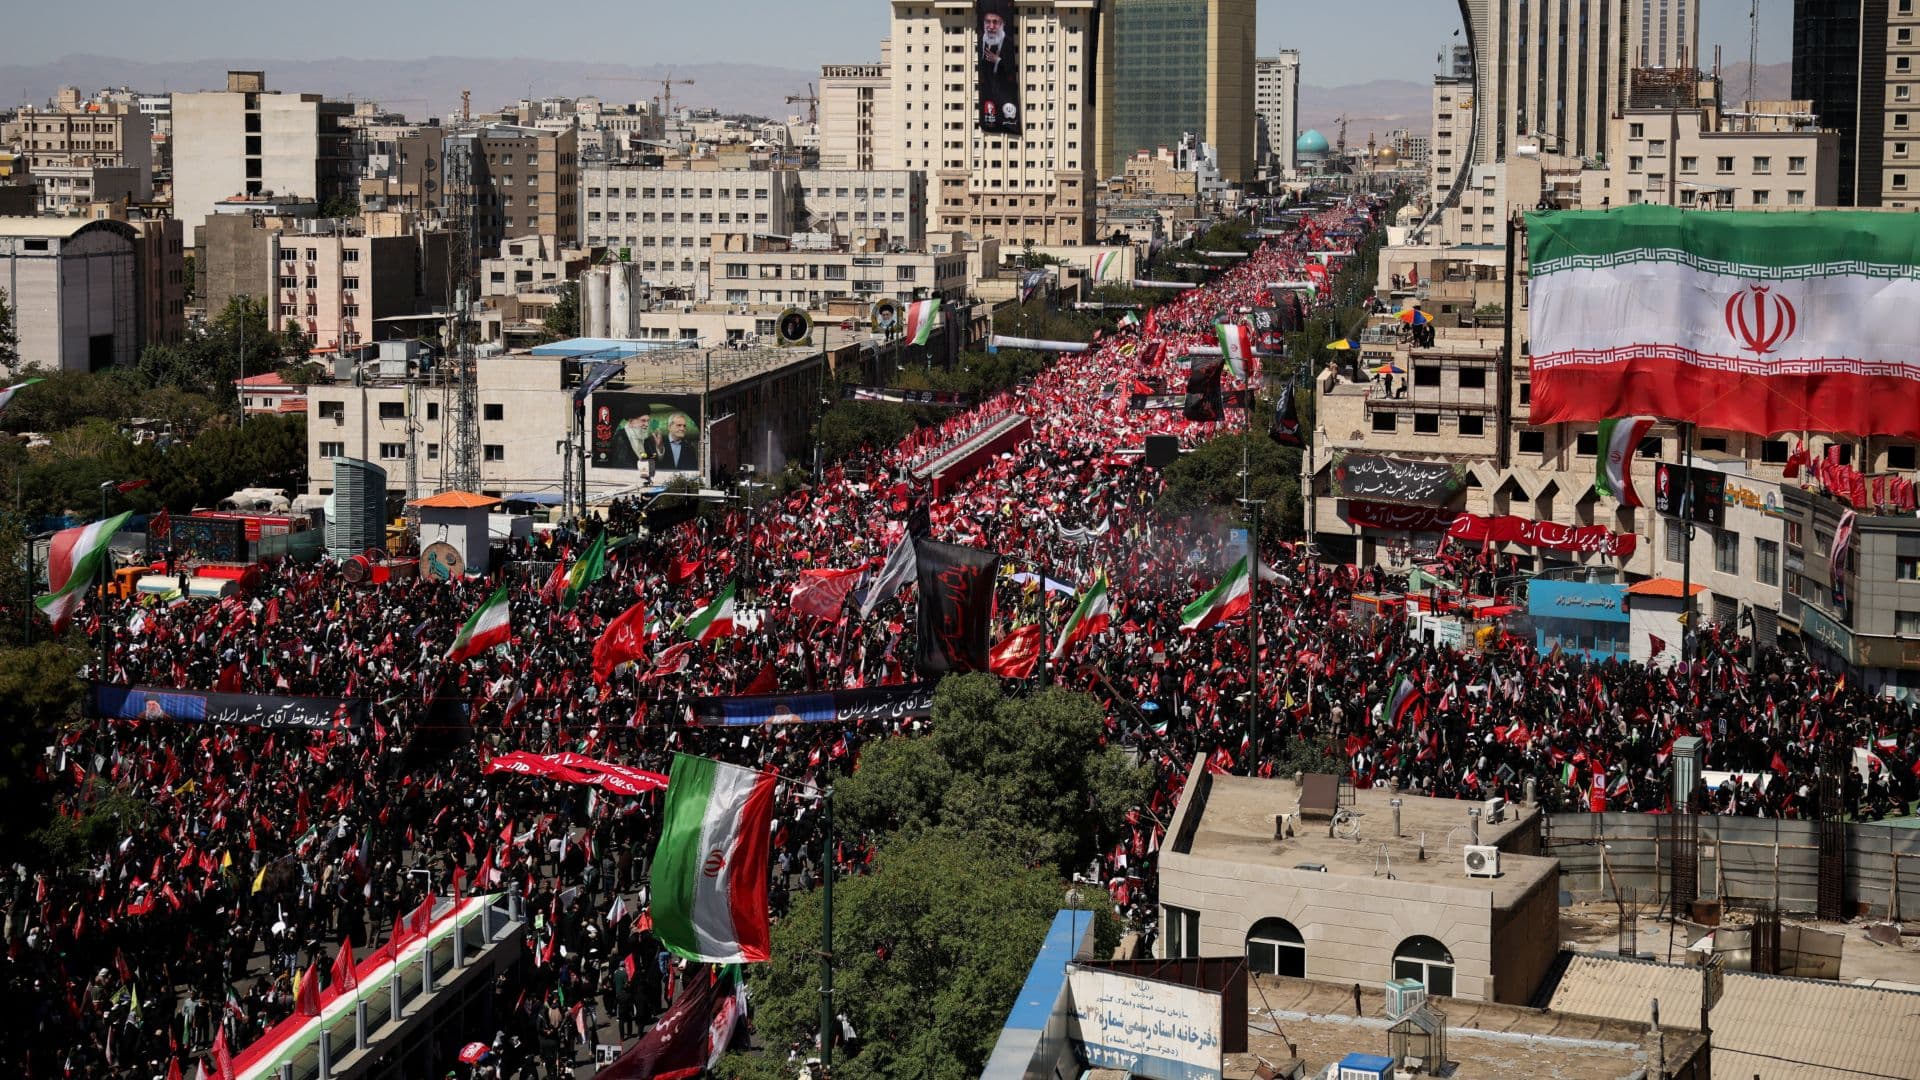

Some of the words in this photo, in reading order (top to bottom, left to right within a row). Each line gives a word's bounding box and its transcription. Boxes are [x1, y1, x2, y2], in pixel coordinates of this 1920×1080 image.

[838, 700, 869, 720] ایران
[871, 693, 894, 719] شهید
[892, 688, 922, 718] آقای
[207, 708, 239, 723] ایران
[240, 704, 264, 723] شهید
[261, 702, 296, 728] آقای
[288, 707, 331, 727] خداحافظ
[1098, 1009, 1124, 1031] شماره
[1152, 1019, 1176, 1039] اسناد
[1125, 1021, 1152, 1040] رسمی
